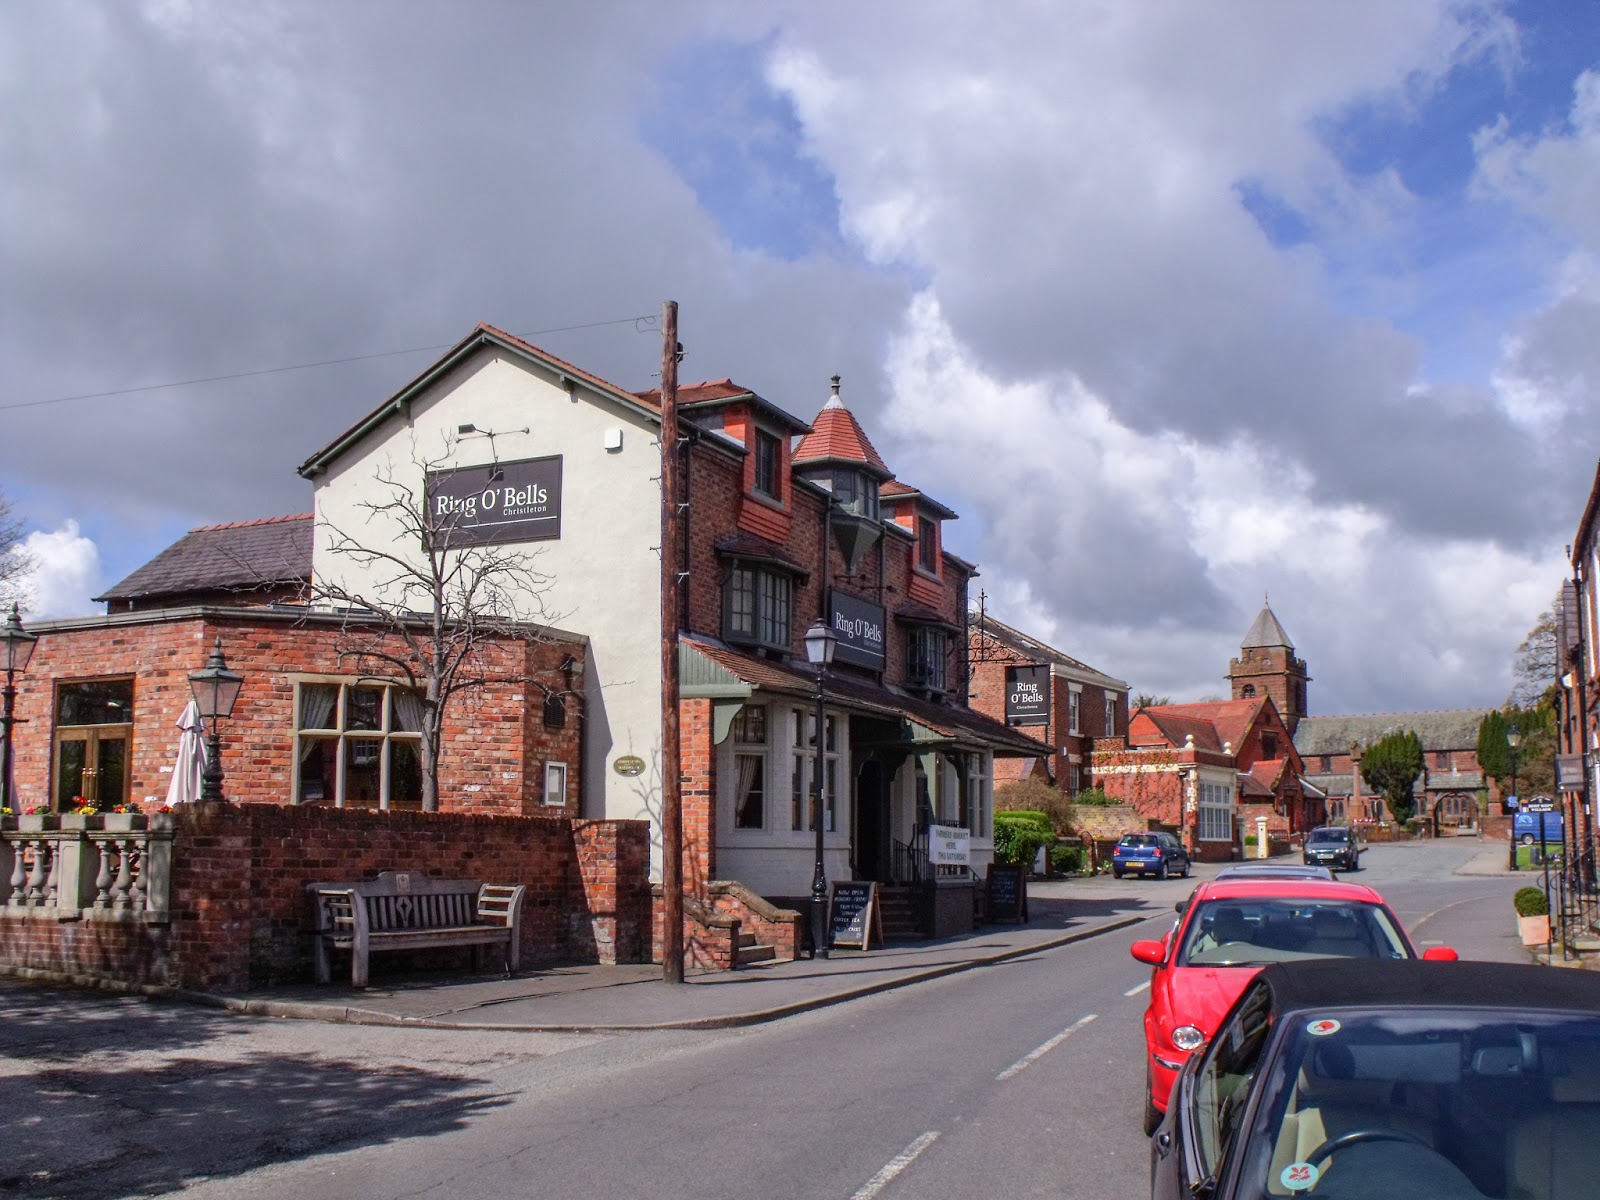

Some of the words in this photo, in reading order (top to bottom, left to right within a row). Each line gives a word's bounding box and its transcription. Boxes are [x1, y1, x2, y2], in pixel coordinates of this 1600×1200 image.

[436, 495, 477, 518] Ring
[481, 489, 501, 510] O'
[503, 484, 548, 507] Bells
[503, 505, 547, 516] Christleton
[836, 612, 854, 639] Ring
[855, 619, 864, 636] O'
[864, 621, 882, 642] Bells
[1017, 682, 1038, 693] Ring
[1011, 693, 1021, 704] O'
[1022, 692, 1044, 703] Bells
